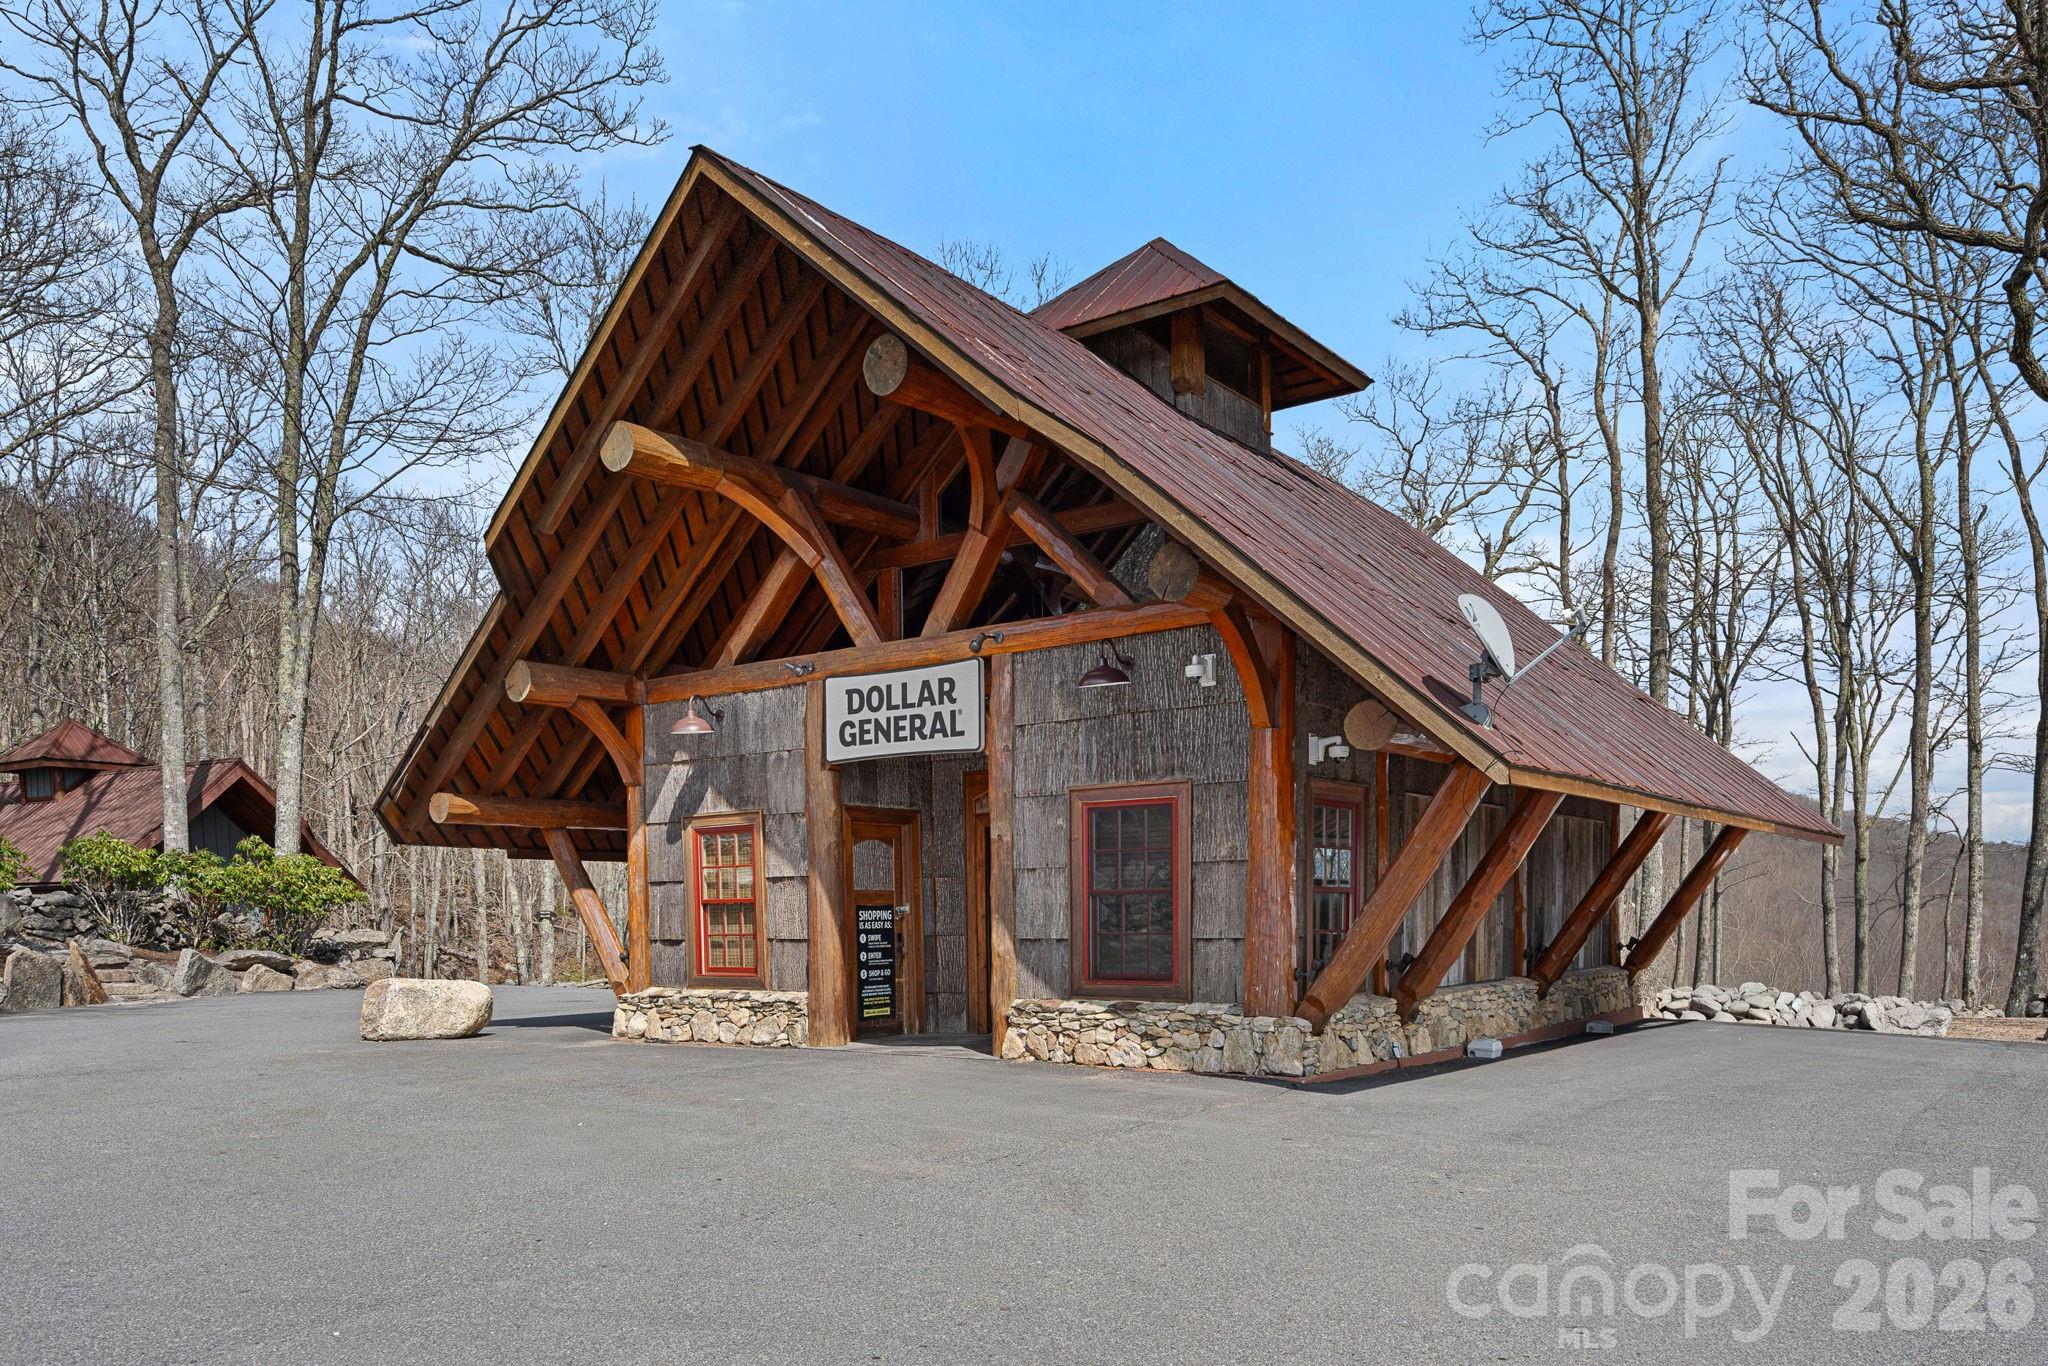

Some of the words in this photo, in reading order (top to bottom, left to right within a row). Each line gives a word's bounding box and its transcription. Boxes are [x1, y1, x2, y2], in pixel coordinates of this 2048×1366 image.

[845, 677, 957, 715] DOLLAR
[839, 710, 965, 747] GENERAL
[859, 910, 892, 920] SHOPPING
[859, 921, 864, 930] IS
[865, 921, 871, 929] AS
[872, 921, 883, 929] EASY
[867, 934, 882, 942] SWIPE
[868, 951, 882, 960] ENTER
[868, 969, 880, 977] SHOP
[884, 968, 891, 976] GO
